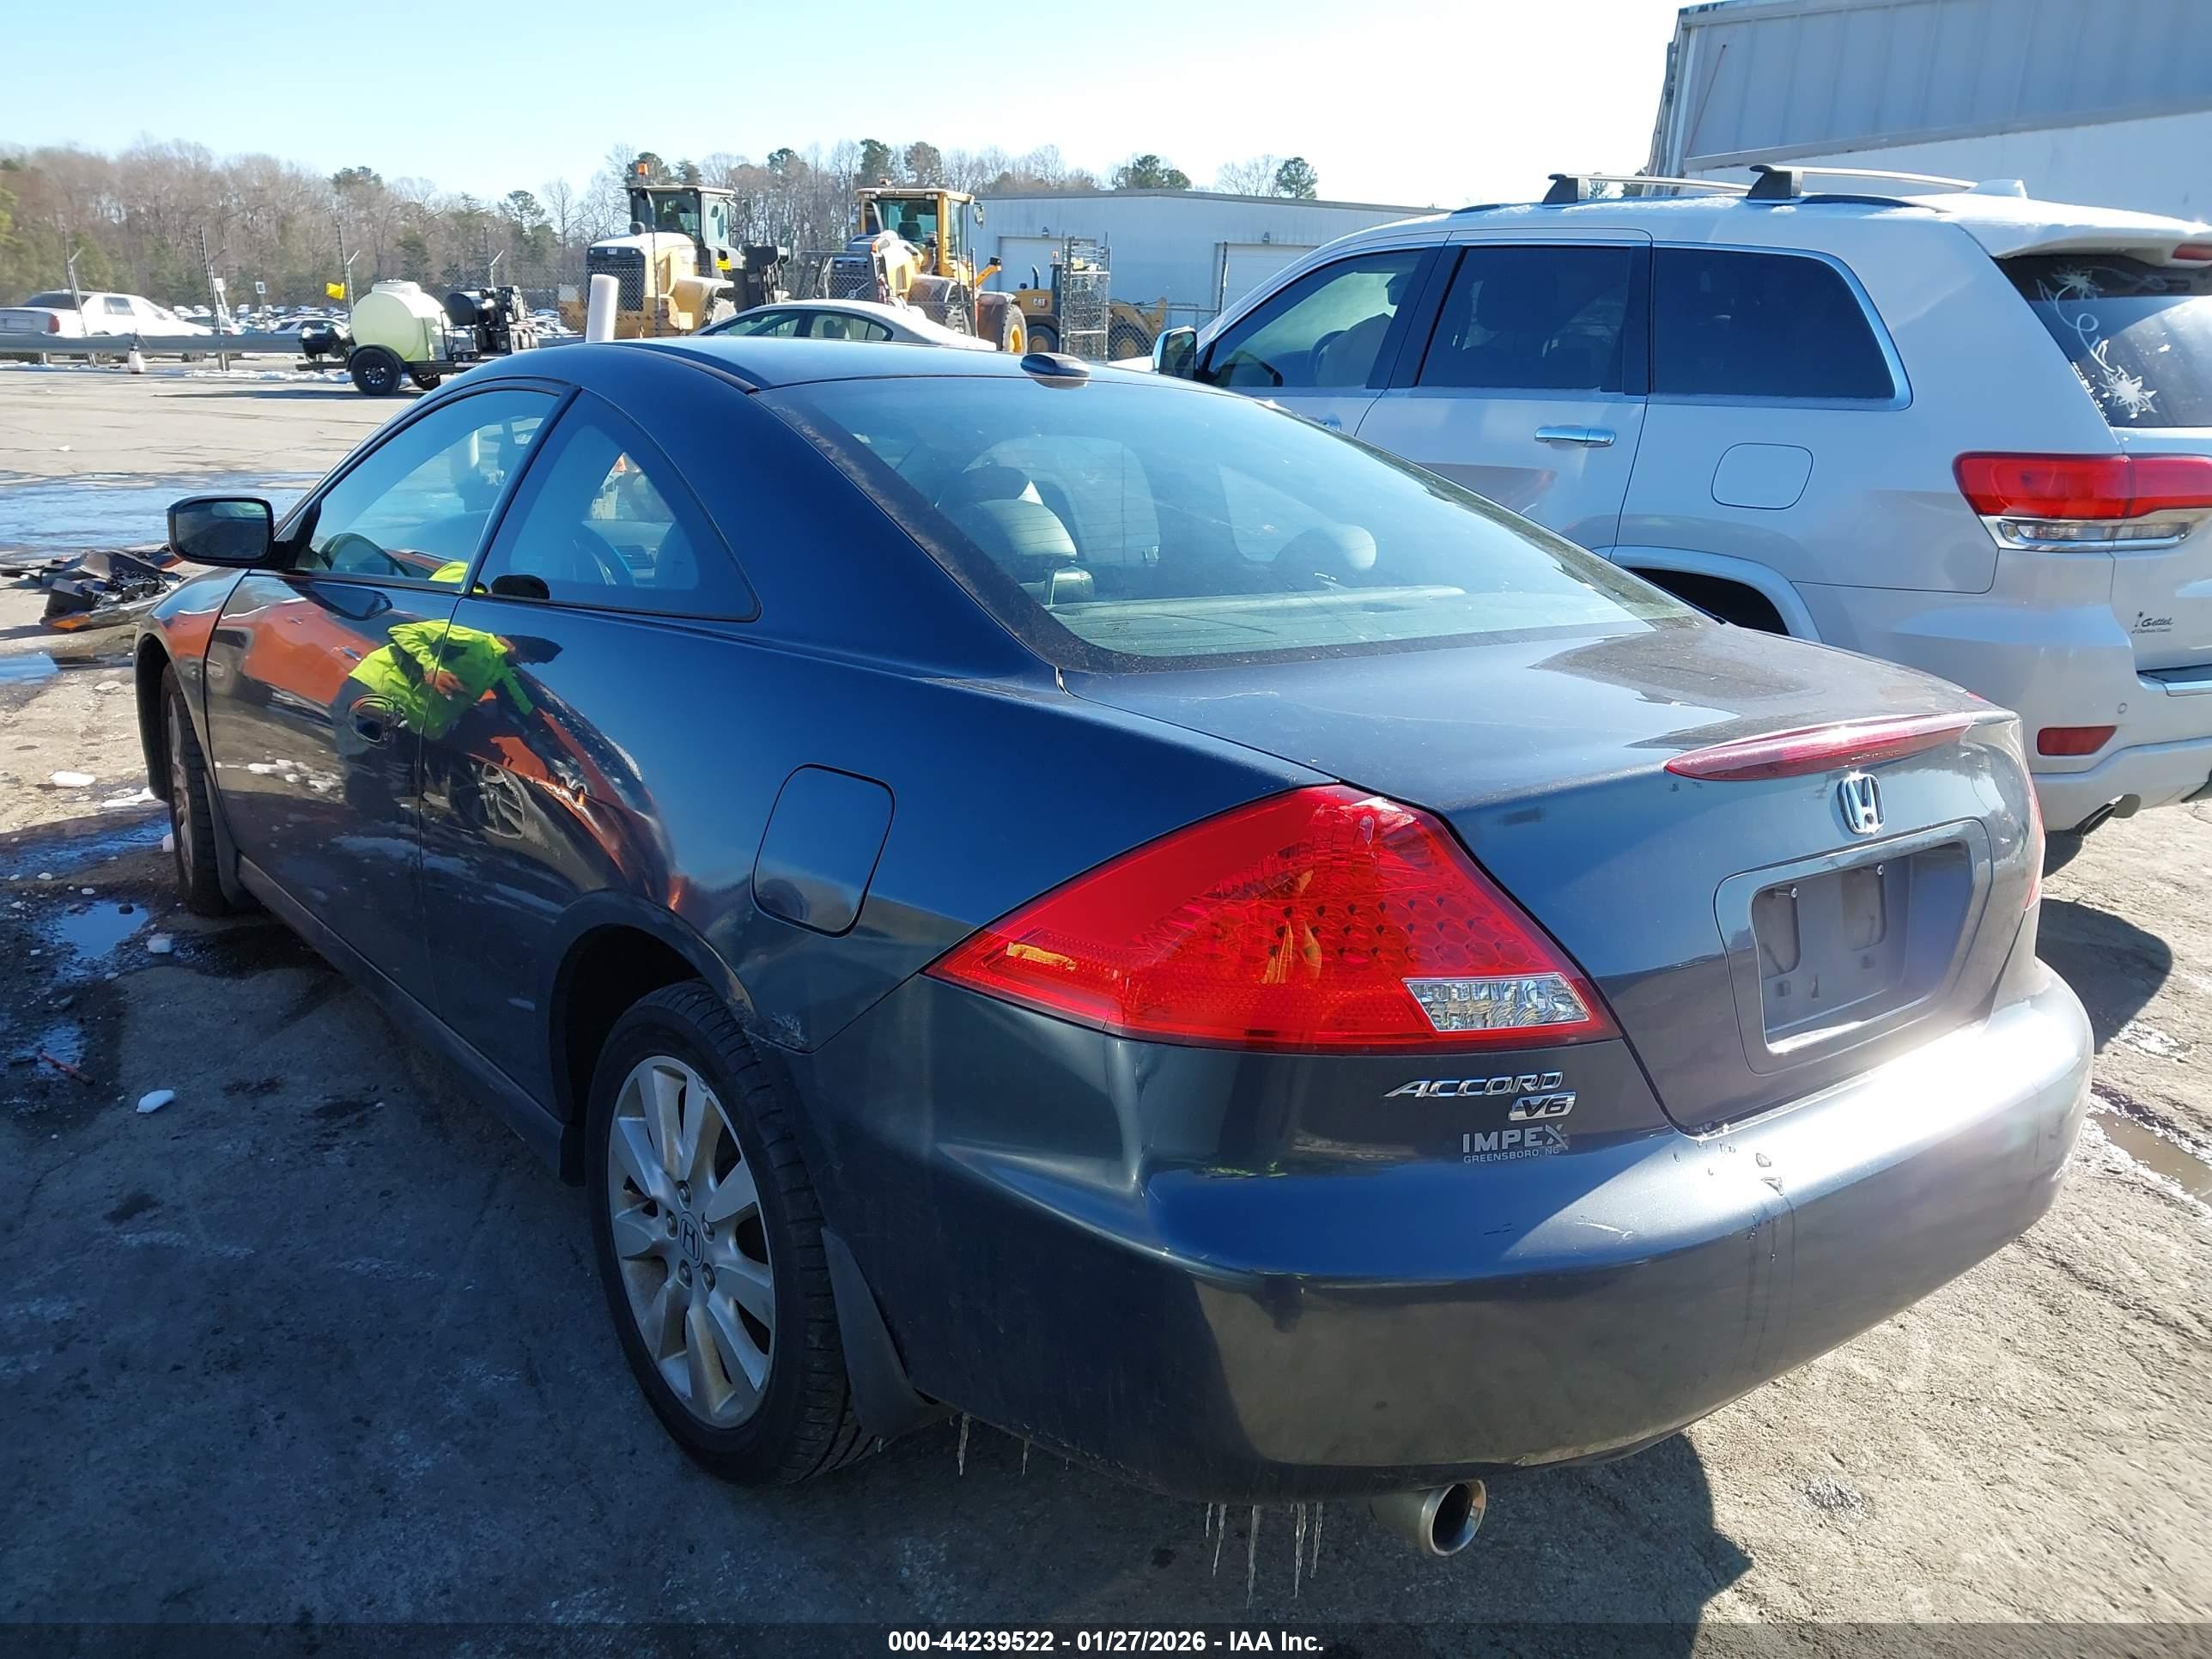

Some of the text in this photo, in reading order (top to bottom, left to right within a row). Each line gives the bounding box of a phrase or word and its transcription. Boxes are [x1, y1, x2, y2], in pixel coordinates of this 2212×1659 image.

[1383, 1071, 1564, 1098] ACCORD
[1521, 1096, 1568, 1117] V6
[1462, 1123, 1568, 1153] IMPEX
[1463, 1148, 1542, 1164] GREENSBORO,
